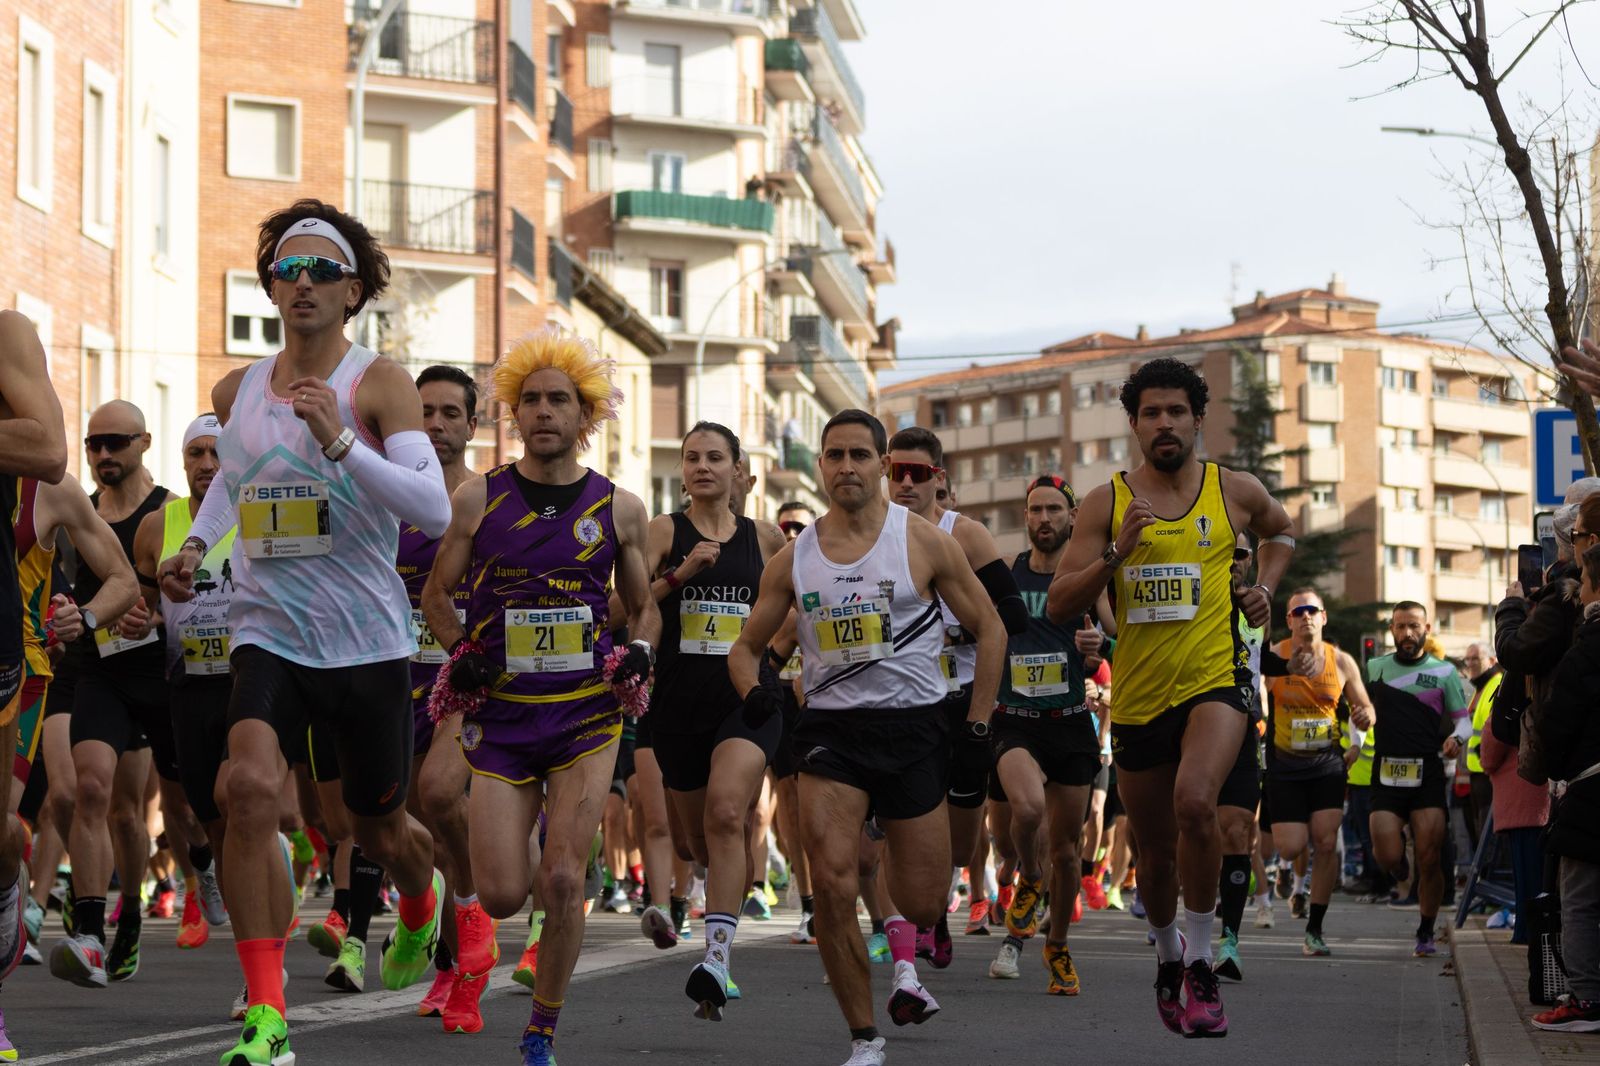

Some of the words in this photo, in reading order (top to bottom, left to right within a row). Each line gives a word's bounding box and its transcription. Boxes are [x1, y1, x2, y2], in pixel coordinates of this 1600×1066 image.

[257, 486, 318, 499] SETEL
[271, 503, 277, 531] 1
[494, 566, 528, 576] Jamón
[1142, 567, 1193, 578] SETEL
[548, 578, 582, 591] PRIM
[1133, 579, 1182, 603] 4309
[682, 586, 751, 602] OYSHO
[698, 603, 744, 615] SETEL
[831, 603, 882, 618] SETEL
[528, 611, 584, 623] SETEL
[705, 616, 716, 636] 4
[833, 618, 864, 644] 126
[535, 626, 554, 650] 21
[201, 639, 223, 657] 29
[1025, 655, 1063, 664] SETEL
[1027, 666, 1045, 682] 37
[1390, 763, 1408, 777] 149
